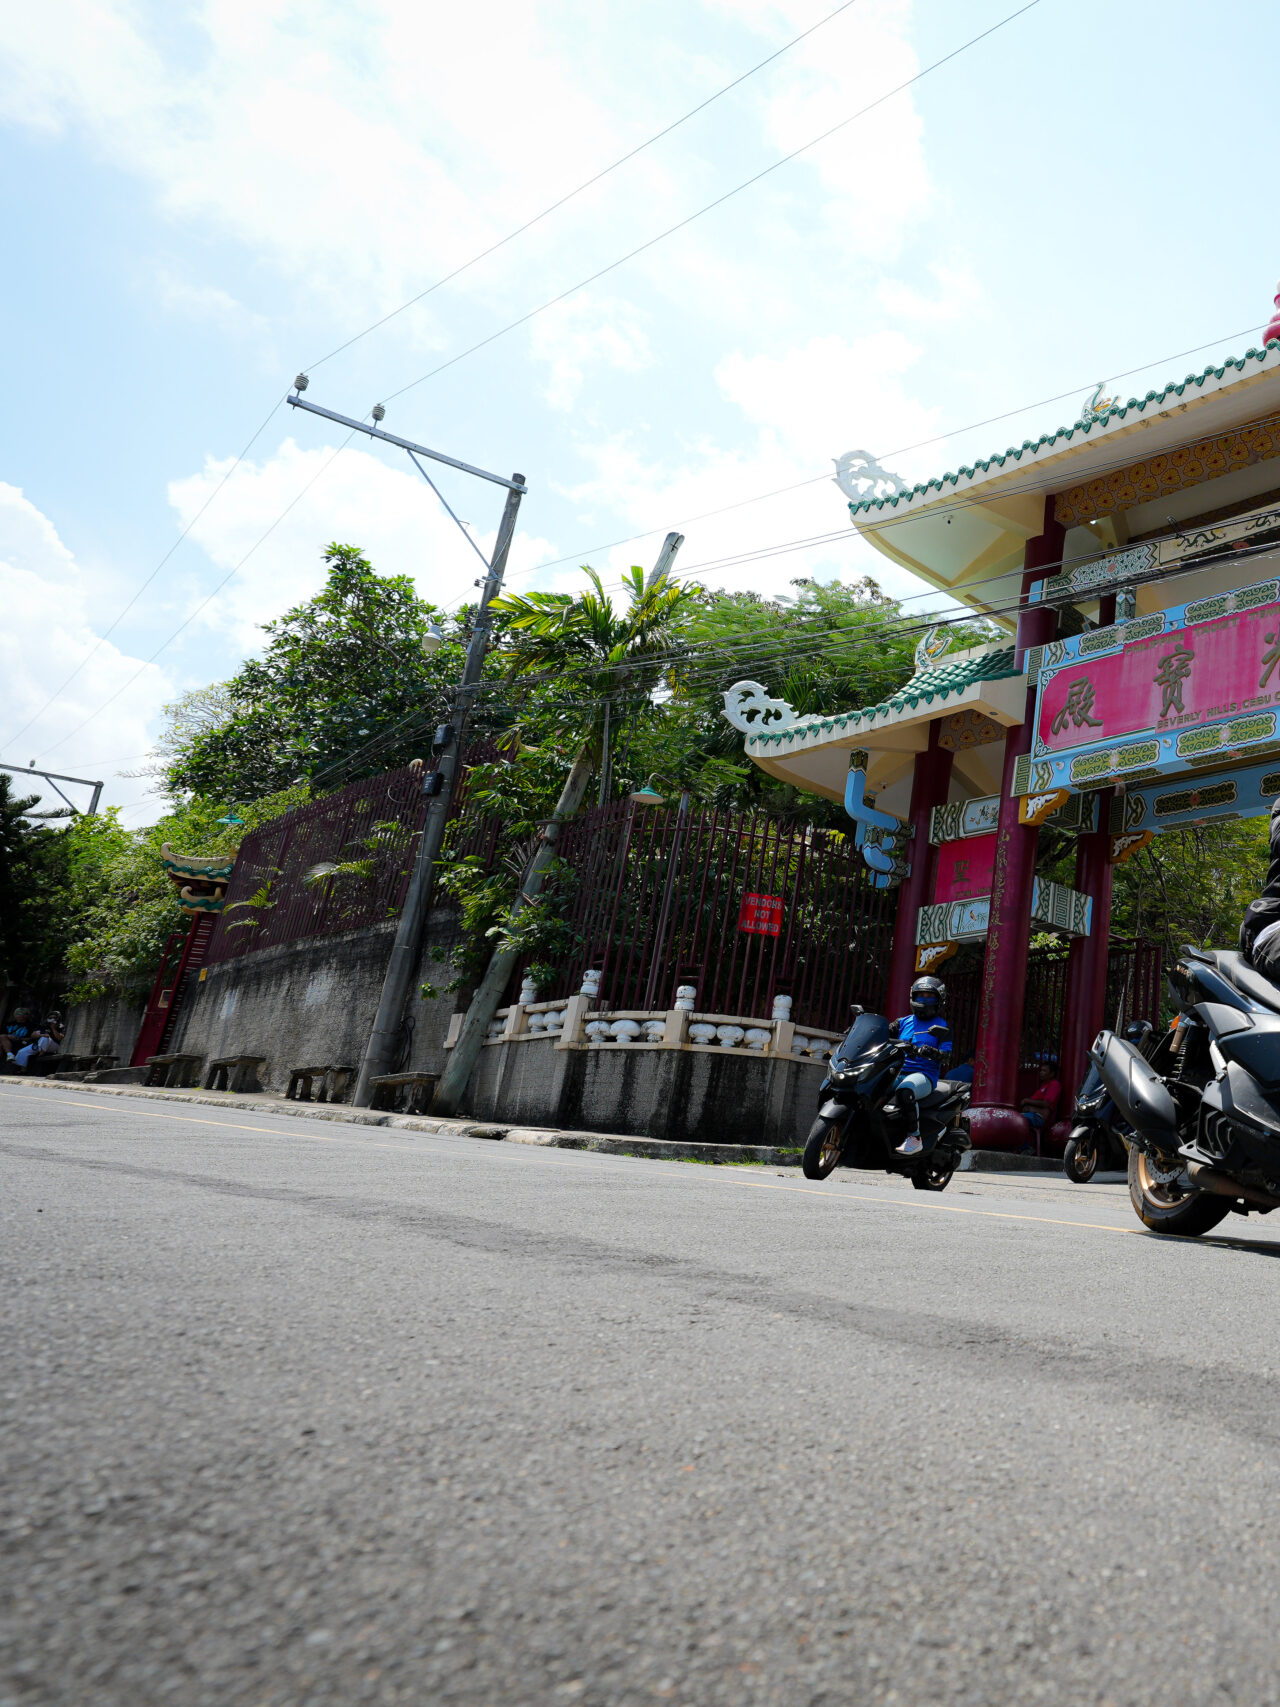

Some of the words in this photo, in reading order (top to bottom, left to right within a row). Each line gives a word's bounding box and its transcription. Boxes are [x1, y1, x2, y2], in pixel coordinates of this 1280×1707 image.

[1126, 632, 1185, 656] PHILIPPINE
[1194, 617, 1241, 637] TAOIST
[1157, 711, 1203, 730] BEVERLY
[1242, 693, 1272, 709] CEBU
[742, 920, 779, 932] ALLOWED
[755, 910, 770, 919] NOT
